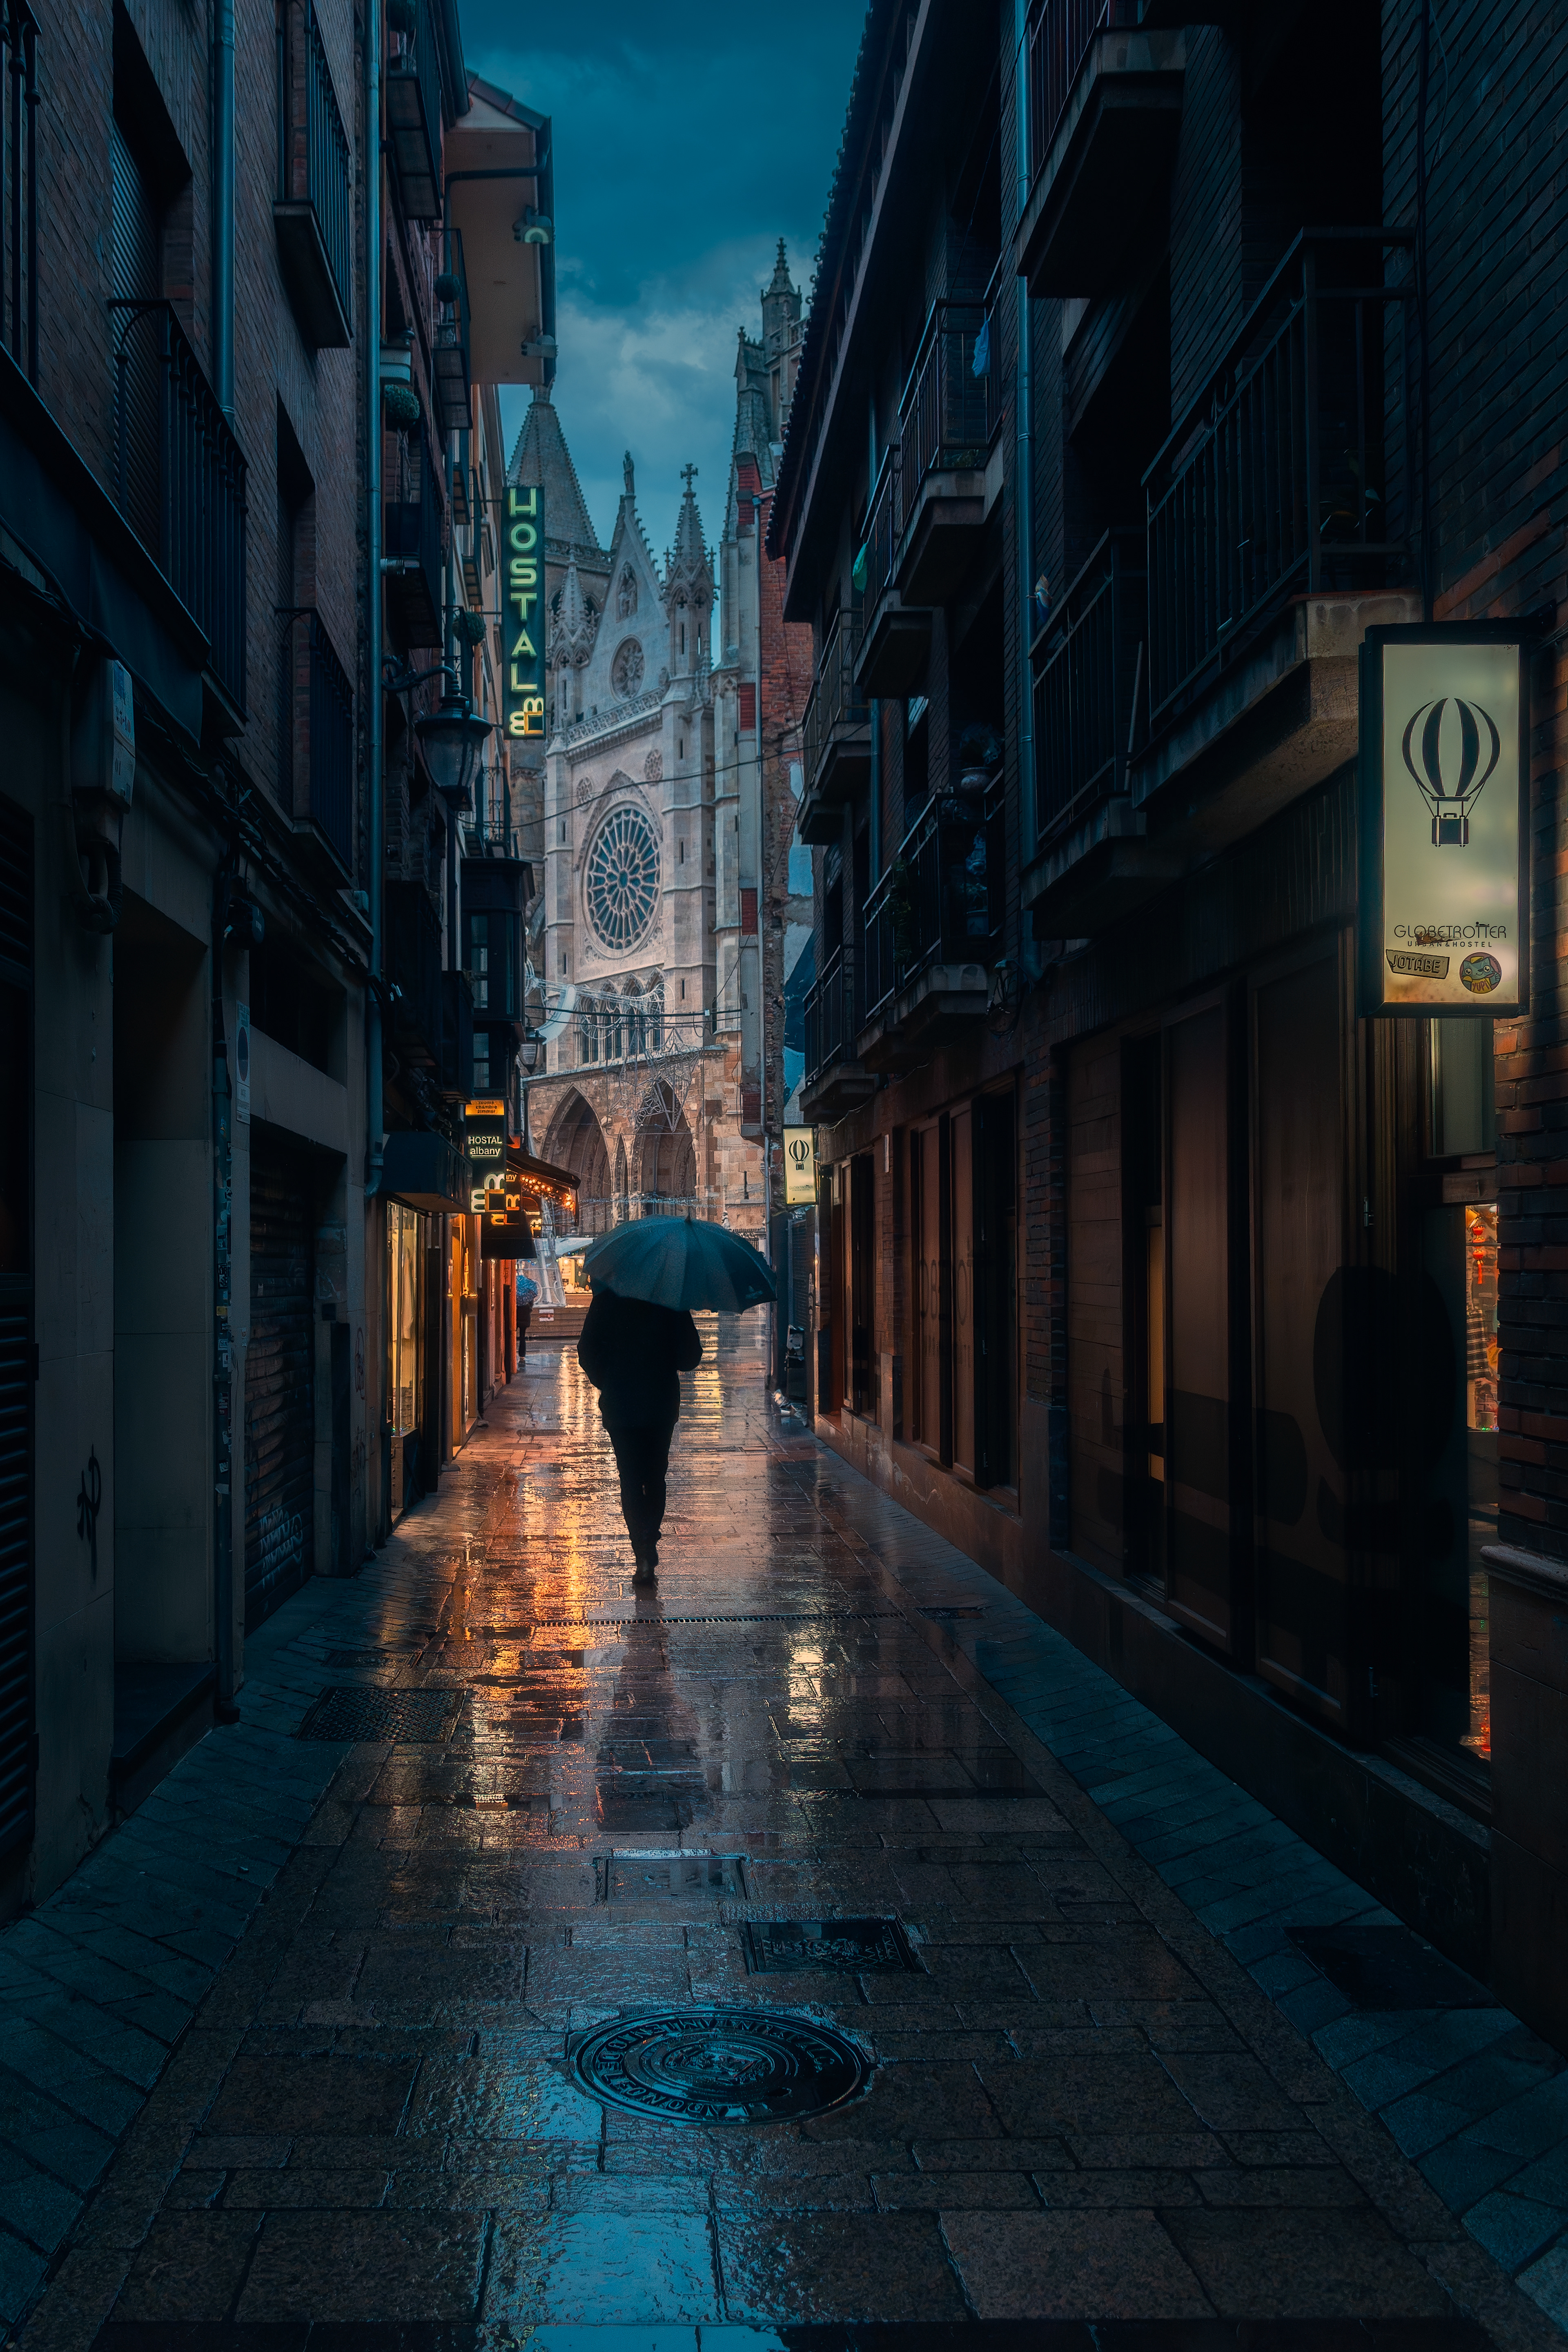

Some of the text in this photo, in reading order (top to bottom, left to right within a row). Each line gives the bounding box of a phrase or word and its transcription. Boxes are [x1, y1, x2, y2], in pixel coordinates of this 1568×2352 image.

[509, 488, 538, 693] HOSTAL
[1394, 924, 1506, 938] GLOBETROTTER
[1393, 954, 1441, 973] JOTABE
[468, 1136, 503, 1145] HOSTAL
[470, 1146, 501, 1157] albany
